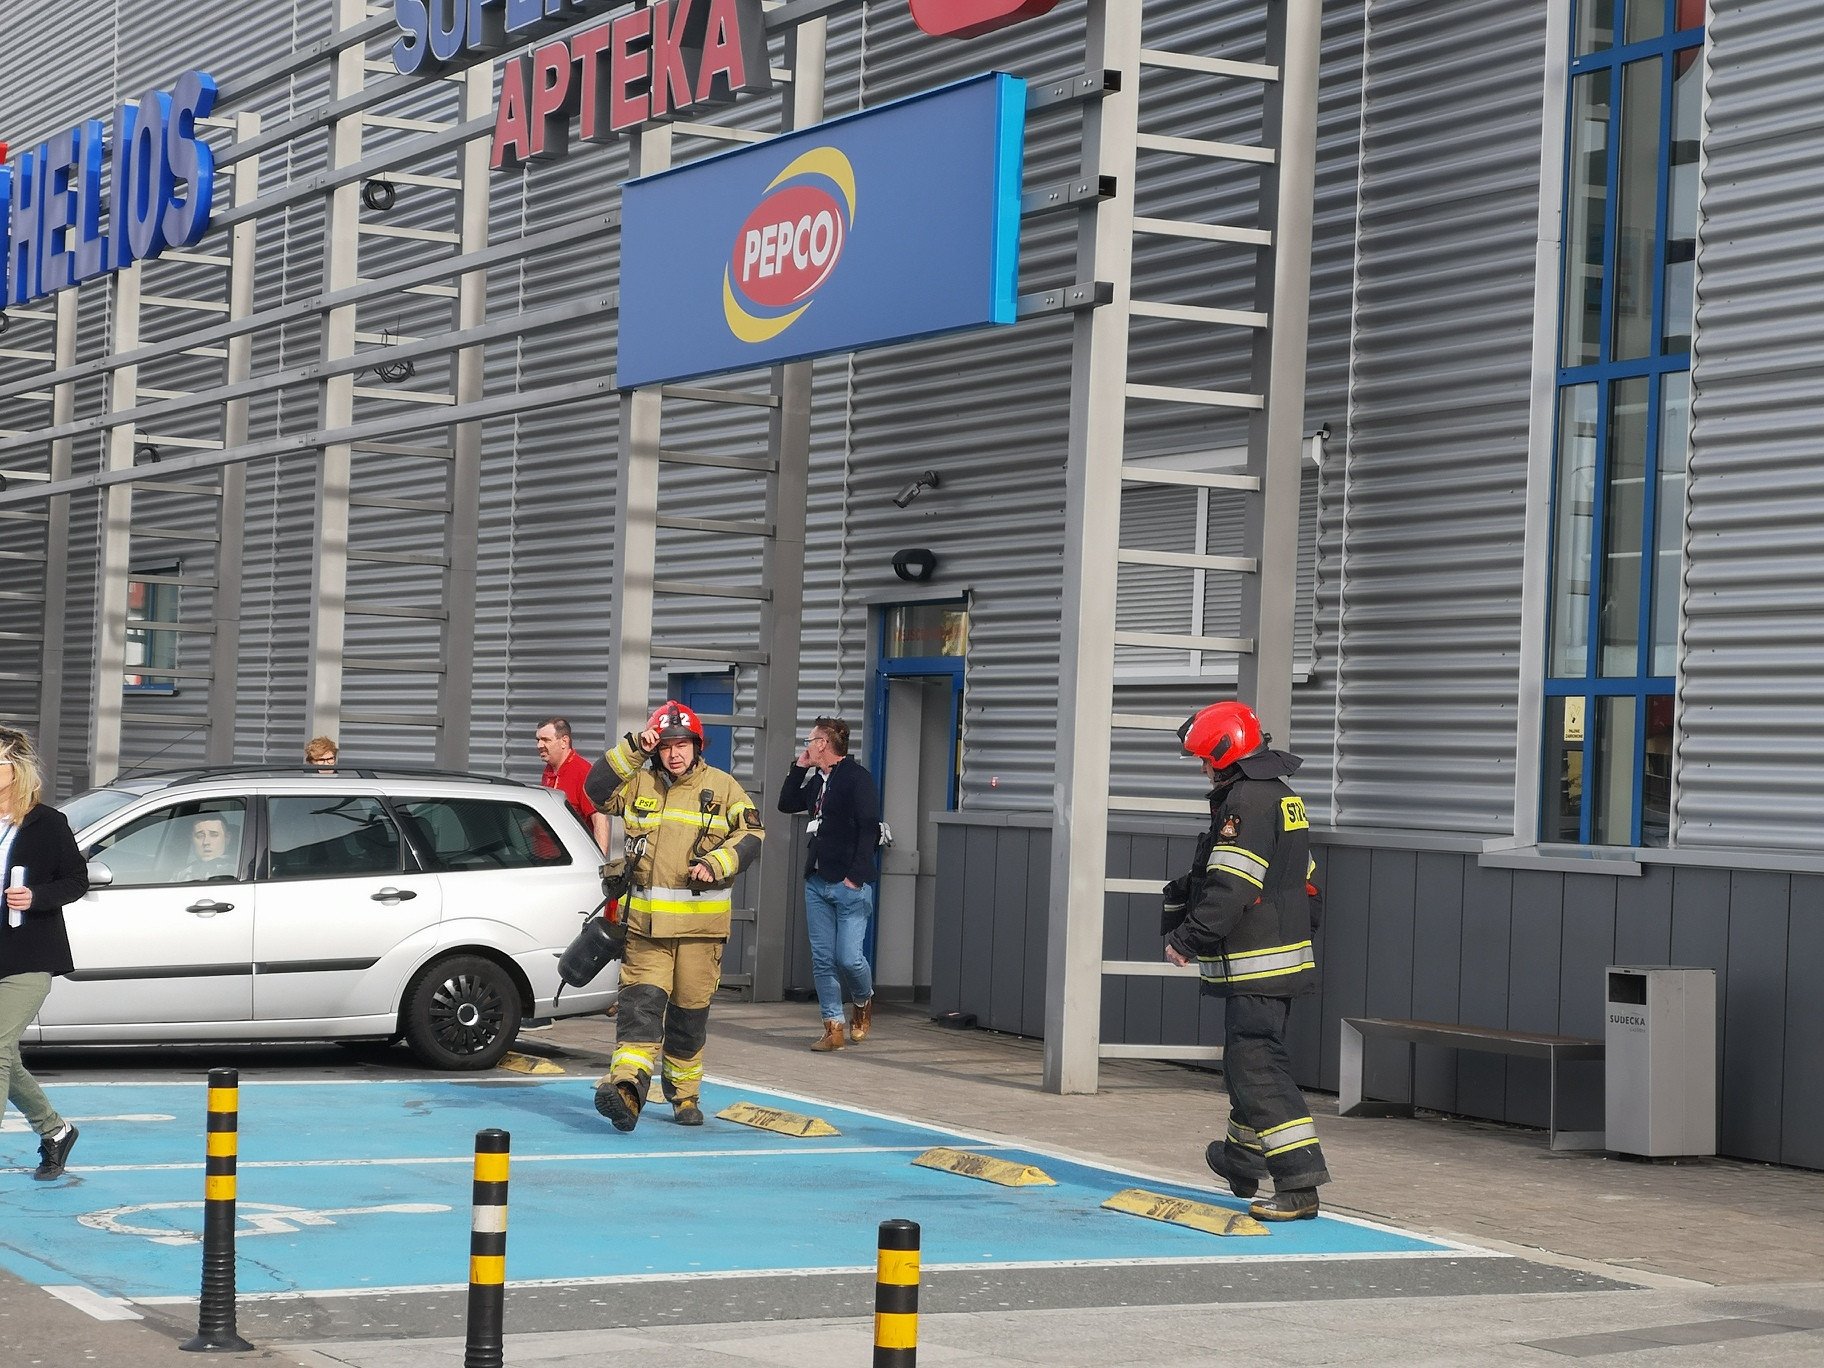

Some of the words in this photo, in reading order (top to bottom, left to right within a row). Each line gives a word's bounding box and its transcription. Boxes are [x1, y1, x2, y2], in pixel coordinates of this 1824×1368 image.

[490, 0, 750, 171] APTEKA
[6, 69, 219, 307] HELIOS
[742, 209, 834, 283] PEPCO
[1609, 1014, 1646, 1026] SUDECKA
